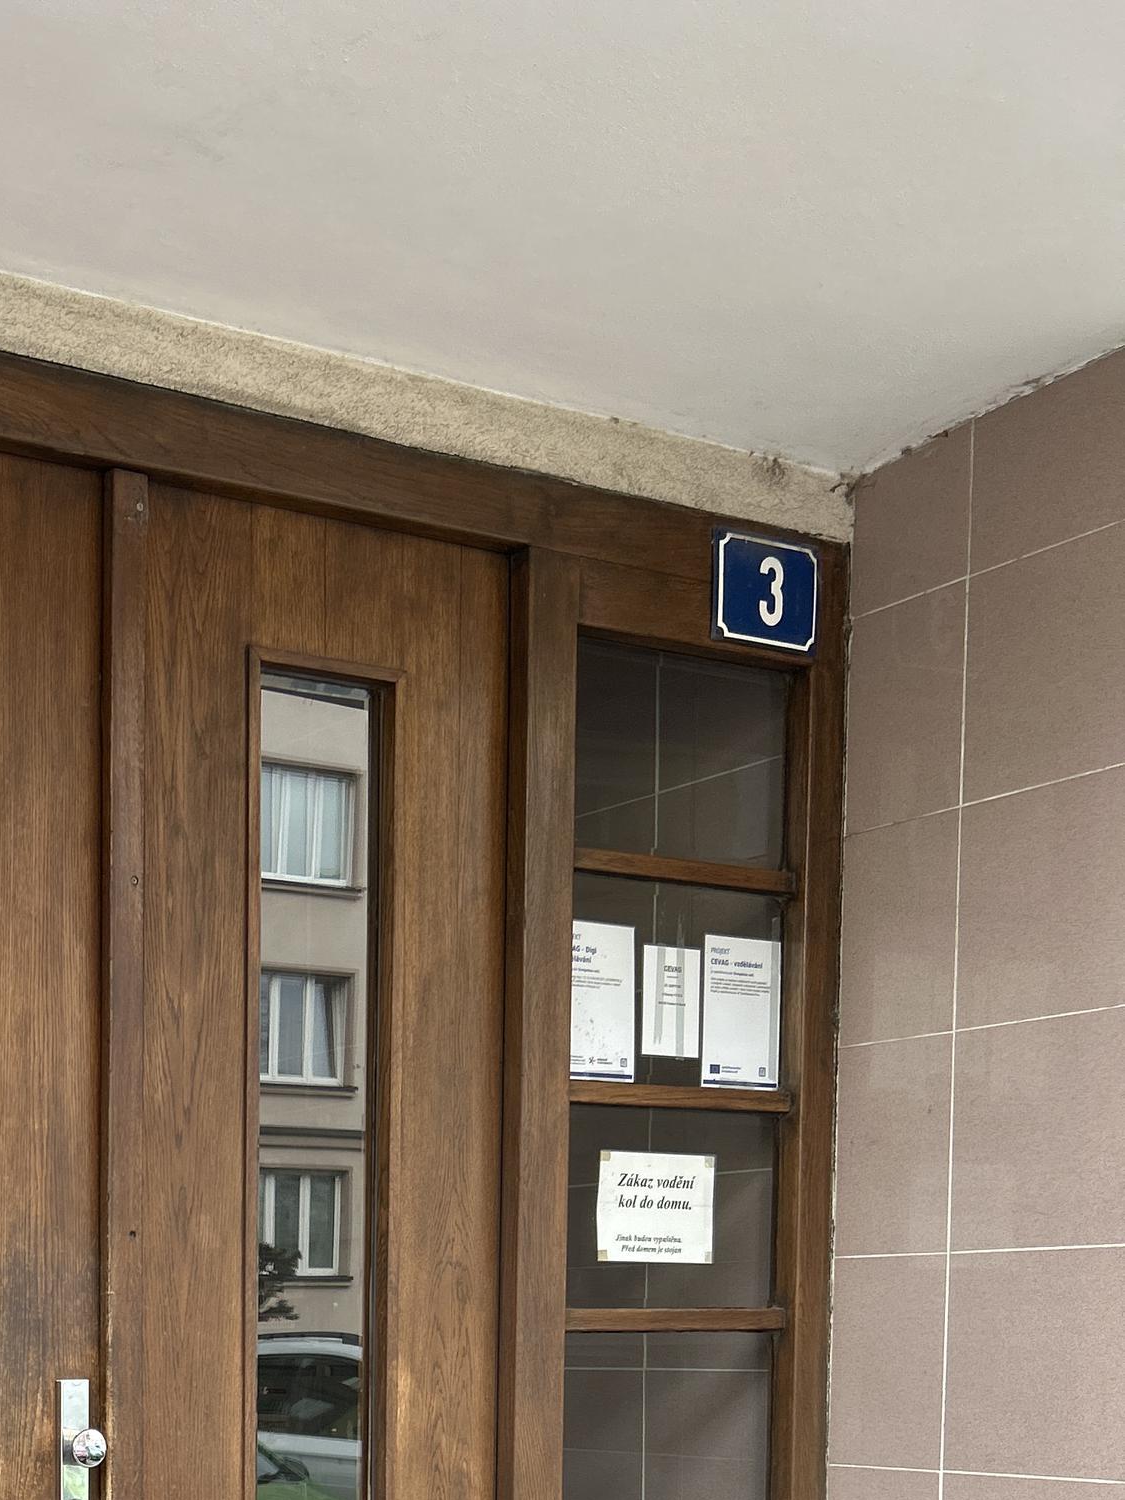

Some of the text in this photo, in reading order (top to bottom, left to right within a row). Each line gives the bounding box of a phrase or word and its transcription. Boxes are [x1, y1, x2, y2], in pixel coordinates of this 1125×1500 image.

[759, 556, 784, 627] 3
[618, 1173, 696, 1190] Zákaz vodění
[618, 1194, 692, 1211] kol do domu.
